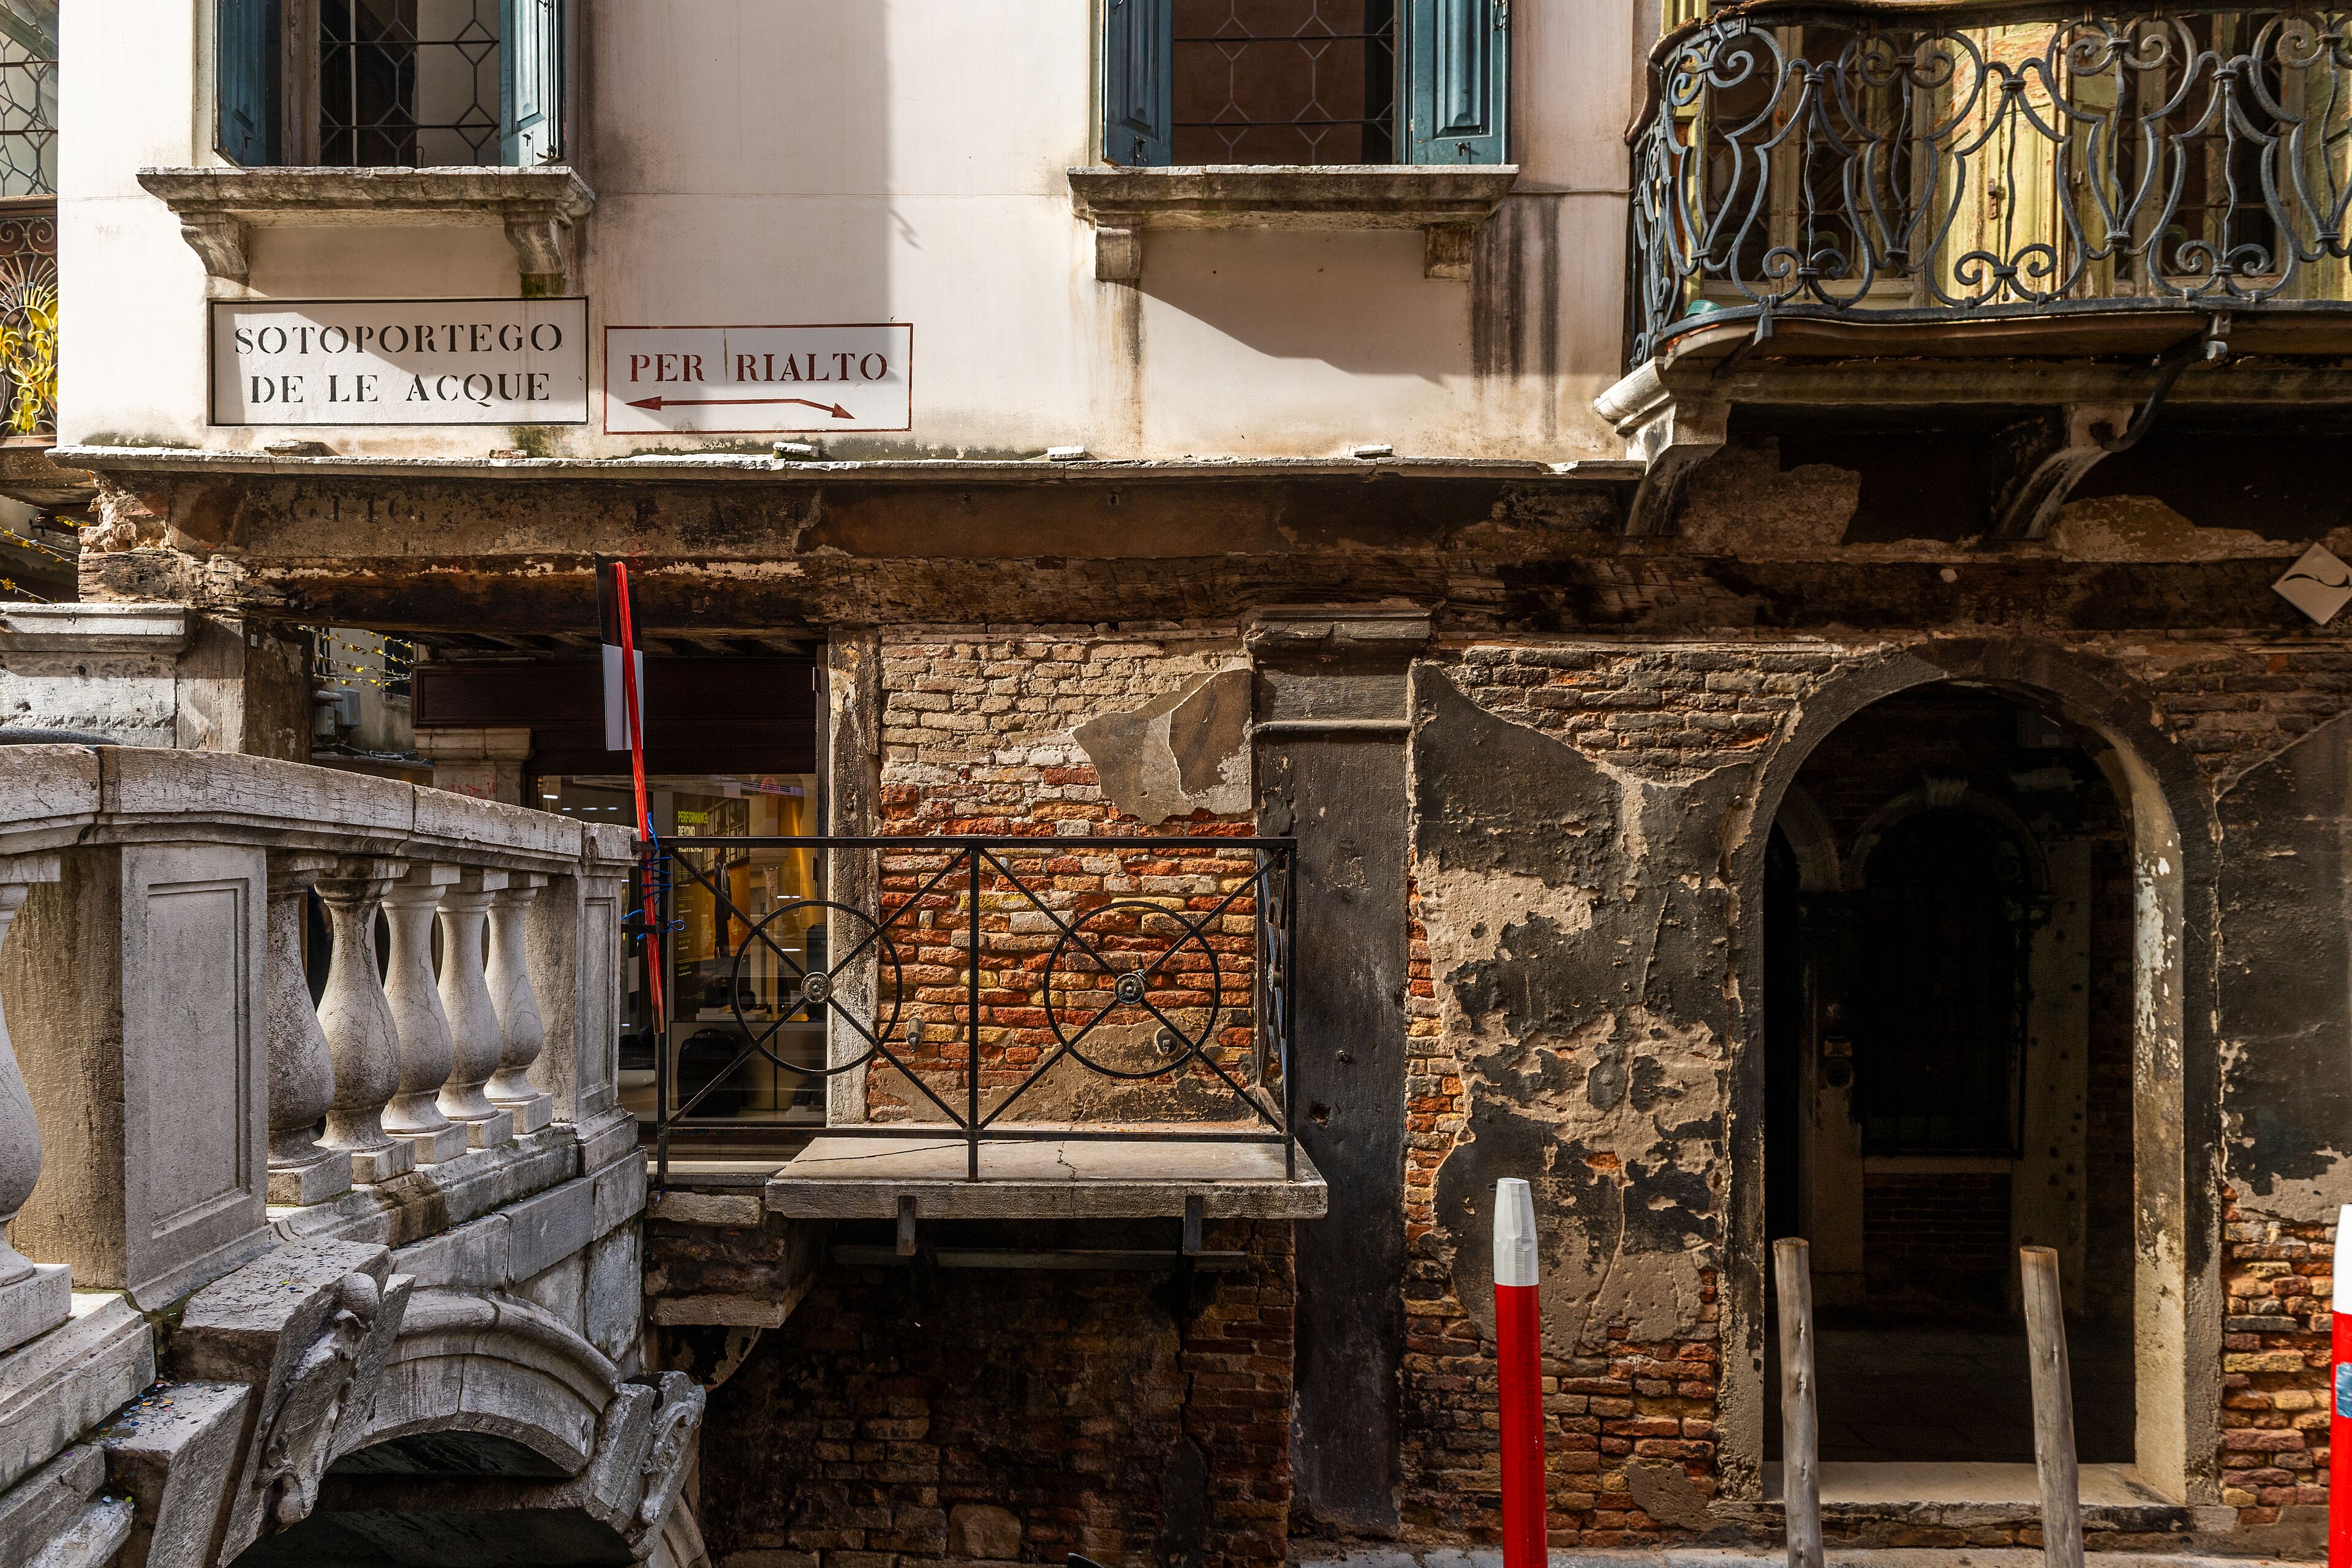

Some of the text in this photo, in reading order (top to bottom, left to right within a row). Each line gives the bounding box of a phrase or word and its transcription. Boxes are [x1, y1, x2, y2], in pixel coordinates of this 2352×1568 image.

[235, 323, 562, 355] SOTOPORTEGO
[629, 352, 888, 382] PER RIALTO
[250, 372, 549, 408] DE LE ACQUE
[677, 810, 708, 824] PERFORMANCE
[677, 825, 695, 837] BEYOND
